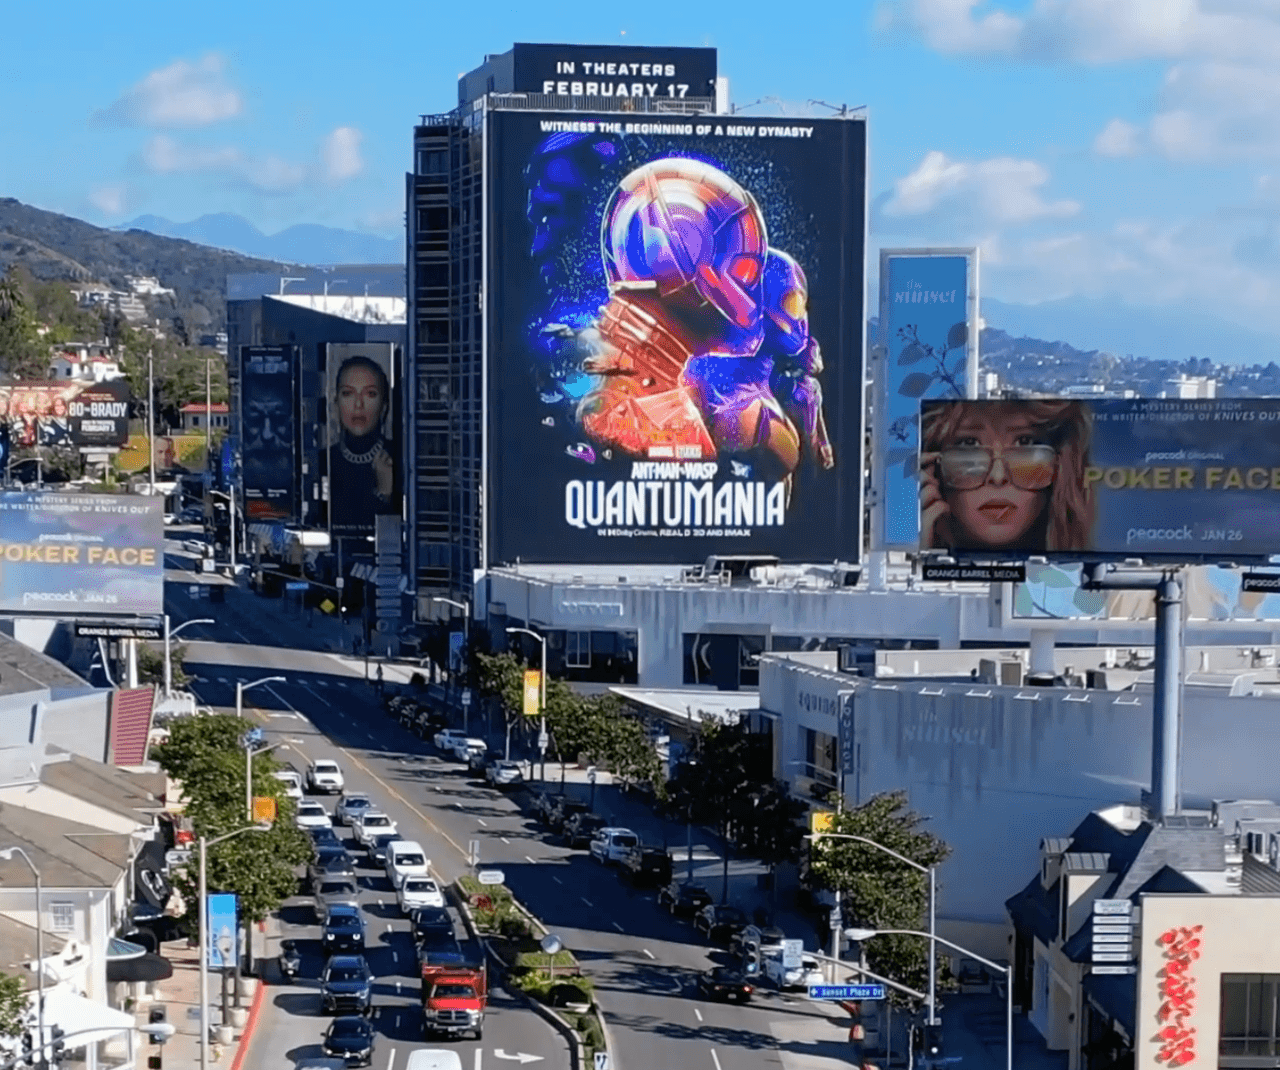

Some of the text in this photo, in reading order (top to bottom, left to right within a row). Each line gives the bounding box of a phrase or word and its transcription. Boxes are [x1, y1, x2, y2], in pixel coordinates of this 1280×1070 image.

[557, 62, 675, 76] IN THEATERS
[543, 81, 689, 98] FEBRUARY 17
[540, 121, 813, 137] WITNESS THE BEGINNING OF A NEW DYNASTY
[69, 402, 83, 417] 80
[91, 402, 127, 417] BRADY
[1131, 403, 1242, 411] A MYSTERY SERIES FROM
[1091, 413, 1107, 421] THE
[1198, 413, 1210, 421] OF
[1214, 412, 1255, 421] KNIVES
[1145, 450, 1186, 462] peacock
[684, 462, 718, 480] WASP
[1083, 467, 1195, 490] POKER
[130, 506, 150, 514] OUT
[565, 480, 784, 528] QUANTUMANIA
[724, 529, 751, 537] IMAX
[1126, 525, 1243, 545] peacock JAN 26
[88, 547, 156, 566] FACE
[926, 569, 1020, 579] ORANGE BARREL MEDIA
[23, 590, 118, 606] peacock JAN 26
[78, 627, 107, 635] ORANGE
[137, 629, 160, 638] MEDIA
[821, 987, 883, 997] Sunset Plaza Dr
